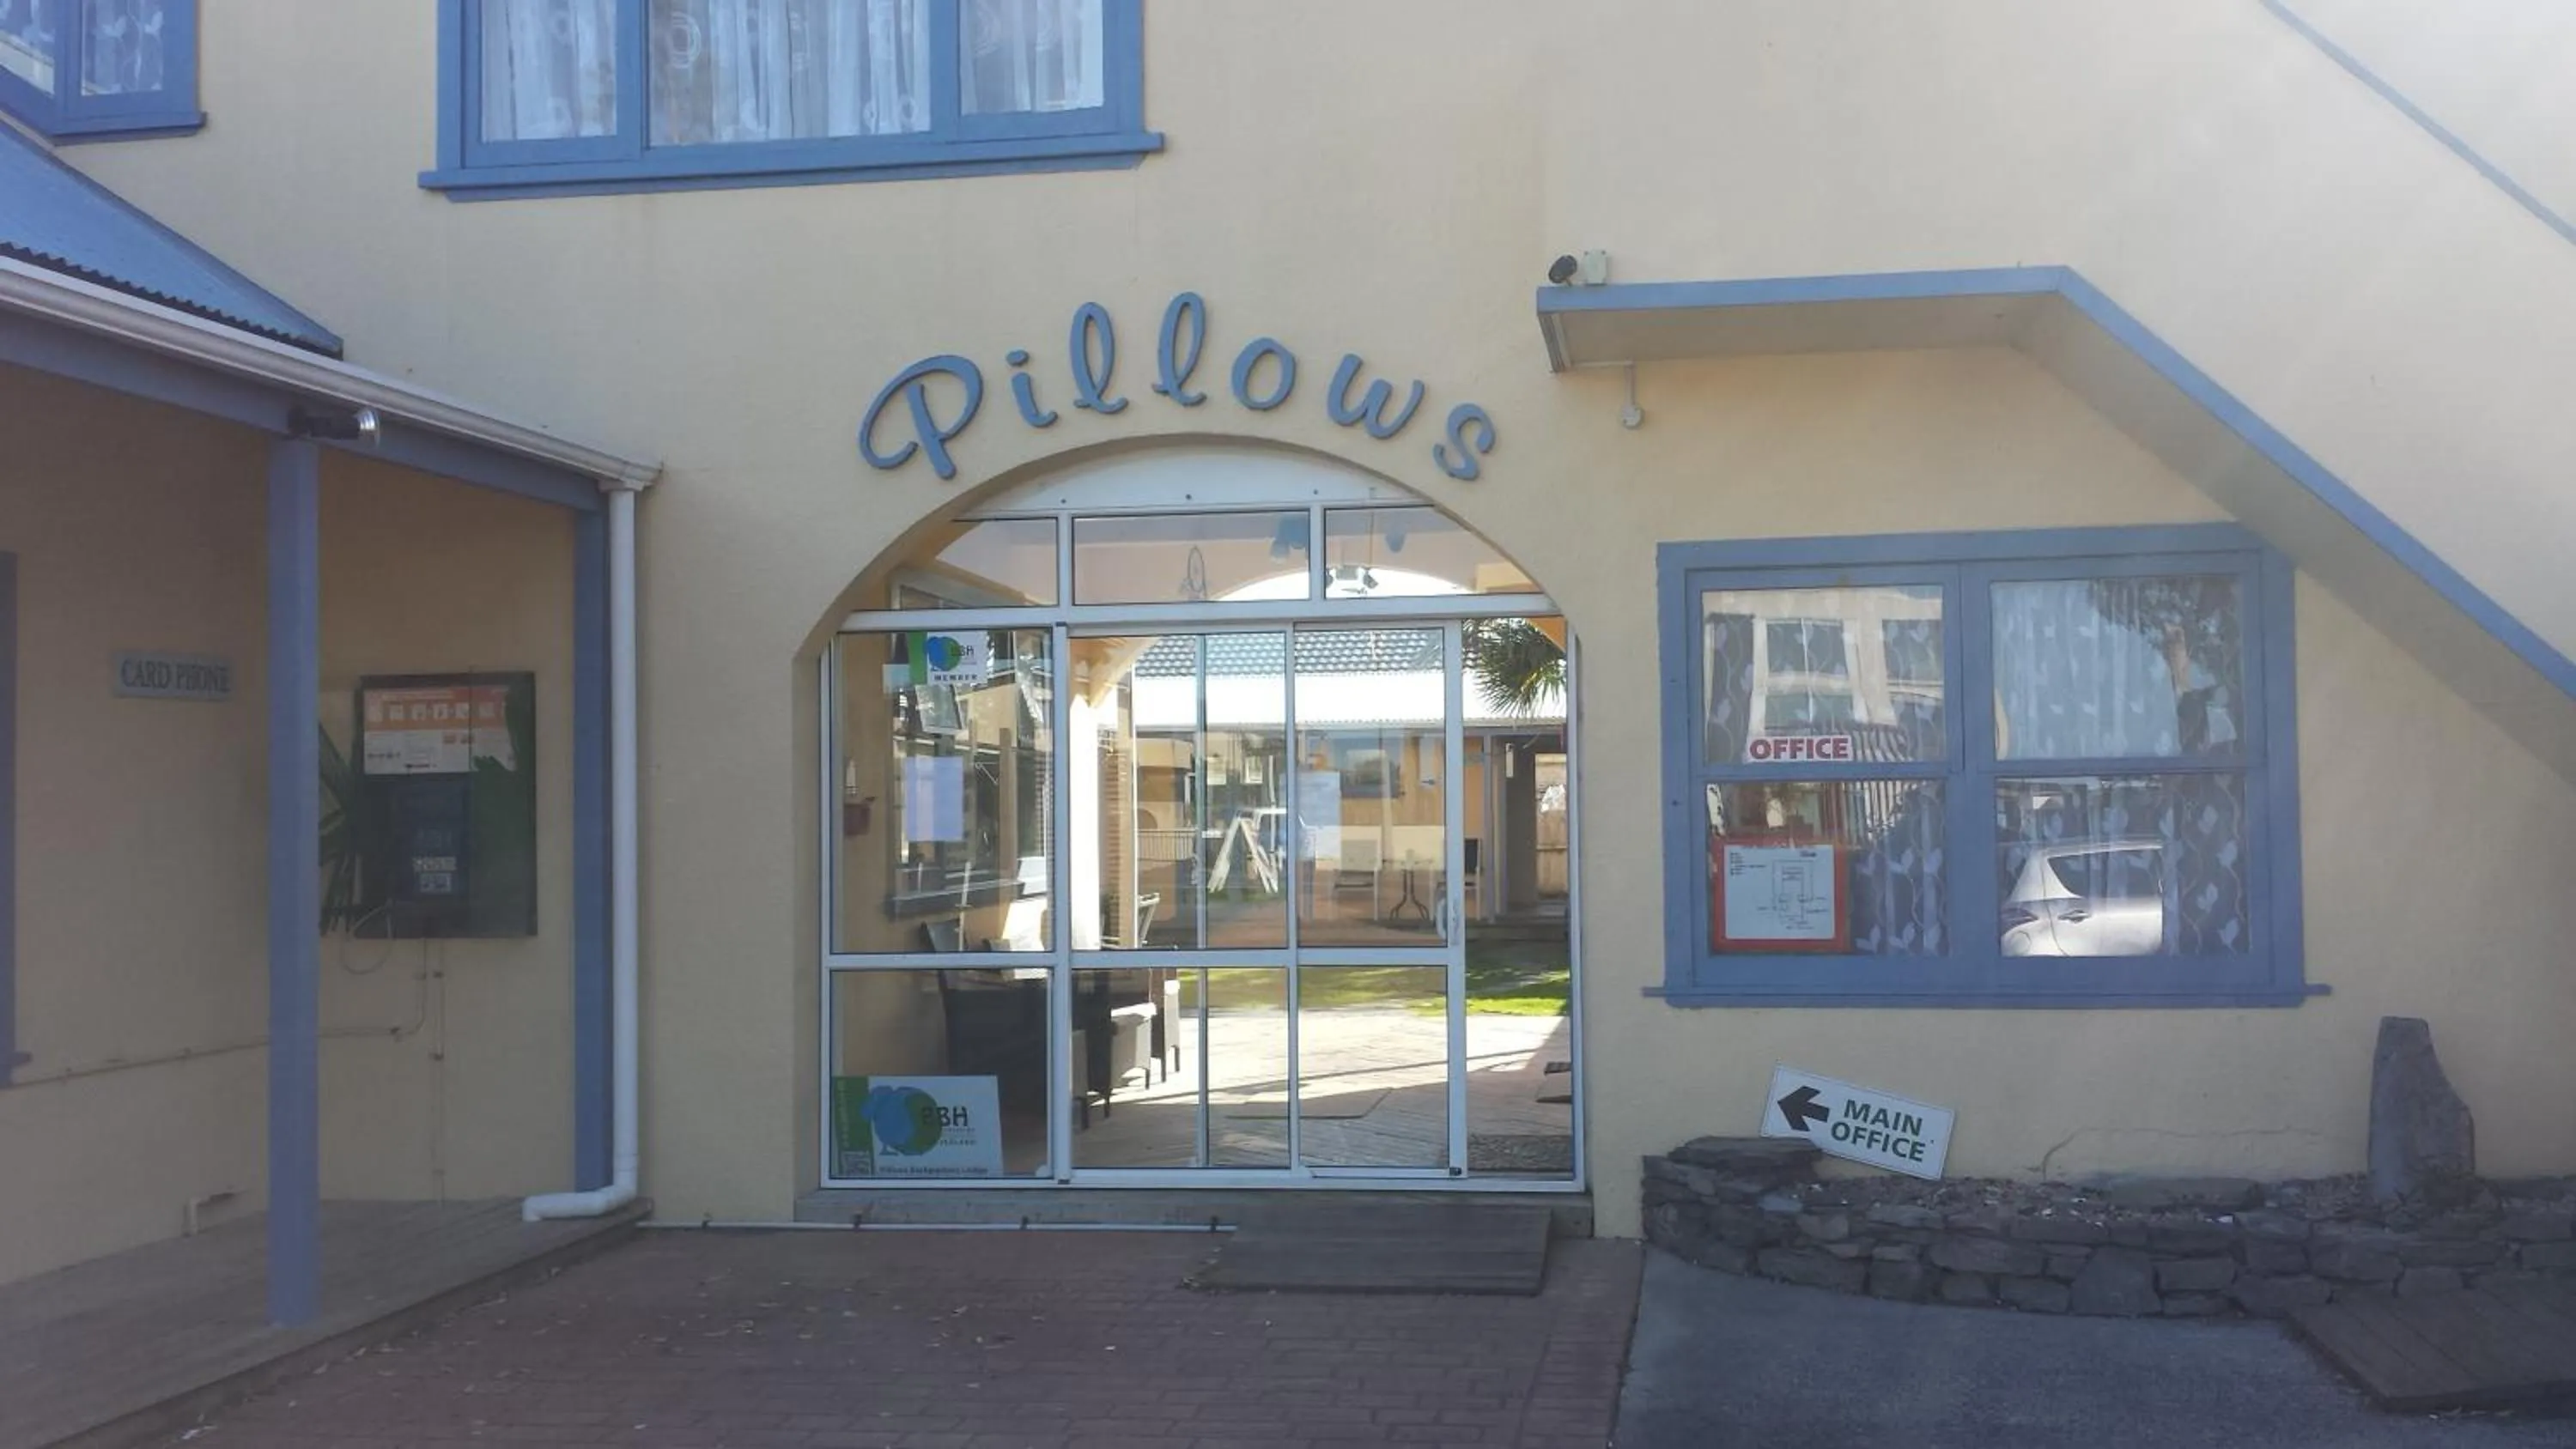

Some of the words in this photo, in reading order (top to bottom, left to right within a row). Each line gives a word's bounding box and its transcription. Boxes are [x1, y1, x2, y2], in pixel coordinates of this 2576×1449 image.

[860, 291, 1496, 480] Pillows
[120, 658, 171, 689] CARD
[175, 663, 231, 694] PHONE
[1750, 738, 1849, 760] OFFICE
[1843, 1099, 1923, 1137] MAIN
[1830, 1122, 1926, 1162] OFFICE
